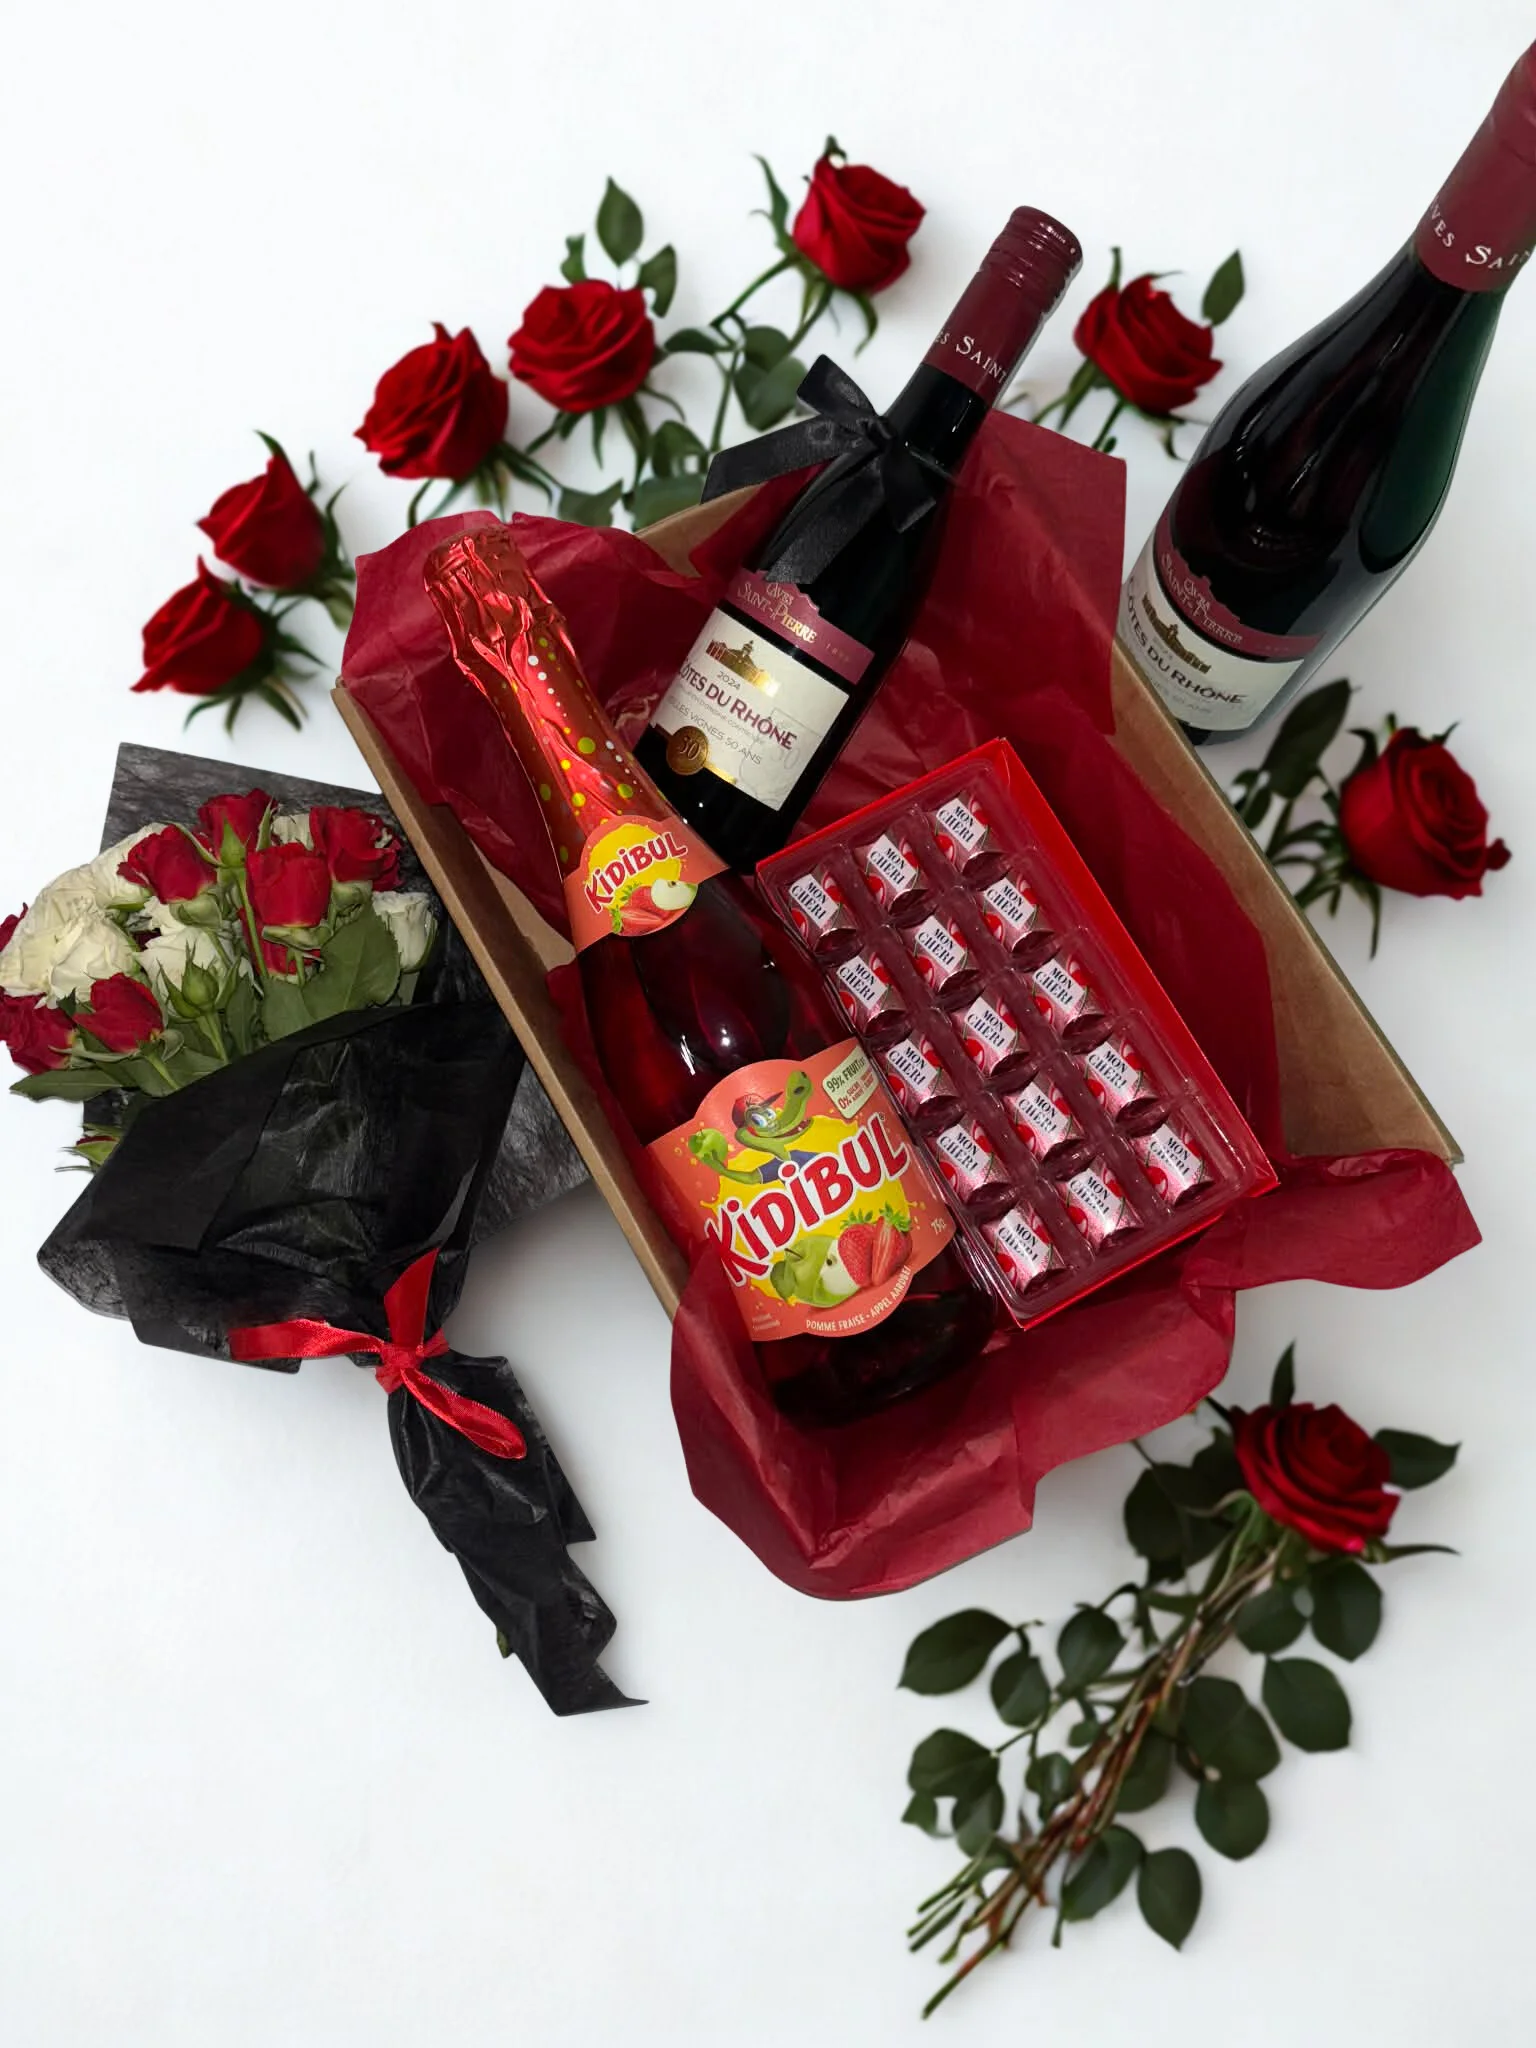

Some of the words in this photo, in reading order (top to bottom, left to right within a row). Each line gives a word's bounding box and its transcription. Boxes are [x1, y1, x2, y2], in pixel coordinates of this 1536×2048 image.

[717, 671, 741, 690] 2024
[1147, 646, 1170, 672] DU
[1171, 669, 1248, 704] RHÔNE
[706, 683, 731, 707] DU
[730, 698, 797, 750] RHÔNE
[690, 711, 726, 740] VIGNES
[738, 747, 762, 765] ANS
[938, 809, 975, 844] CHERI
[955, 806, 975, 828] MON
[870, 851, 906, 886] CHERI
[885, 847, 906, 869] MON
[791, 885, 827, 920] CHERI
[806, 882, 827, 905] MON
[986, 888, 1023, 922] CHERI
[1002, 885, 1024, 906] MON
[918, 931, 956, 965] CHERI
[933, 928, 954, 950] MON
[838, 965, 875, 1001] CHERI
[854, 962, 875, 985] MON
[1051, 967, 1073, 988] MON
[1035, 971, 1073, 1005] CHERI
[967, 1014, 1006, 1047] CHERI
[983, 1010, 1005, 1031] MON
[889, 1050, 926, 1085] CHERI
[904, 1047, 927, 1069] MON
[1104, 1050, 1128, 1073] MON
[826, 1075, 845, 1092] 99%
[1088, 1054, 1128, 1089] CHERI
[838, 1096, 852, 1109] 0%
[1035, 1095, 1057, 1117] MON
[1018, 1098, 1057, 1132] CHERI
[940, 1135, 978, 1171] CHERI
[956, 1132, 978, 1155] MON
[1166, 1137, 1189, 1161] MON
[1086, 1175, 1109, 1200] MON
[1013, 1223, 1036, 1247] MON
[806, 1319, 836, 1331] POMME
[839, 1313, 865, 1330] FRAISE
[870, 1297, 892, 1318] APPEL
[890, 1264, 911, 1300] AARDBEI
